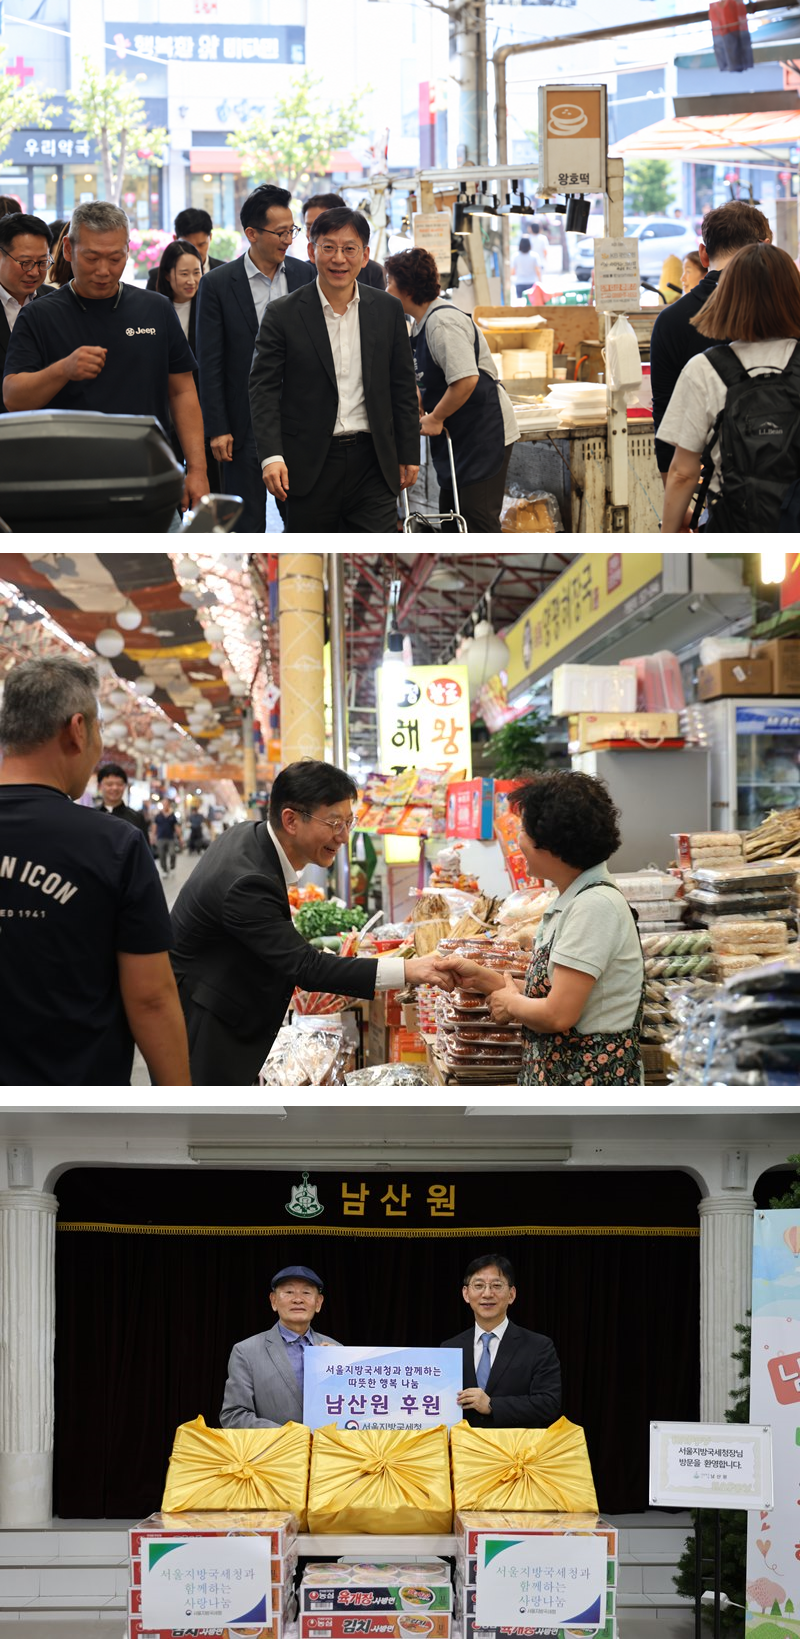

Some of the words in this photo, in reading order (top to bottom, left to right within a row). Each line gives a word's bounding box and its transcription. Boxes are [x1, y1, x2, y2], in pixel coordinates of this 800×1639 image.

[24, 138, 91, 158] 우리약국
[557, 172, 590, 186] 왕호떡
[135, 326, 156, 336] Jeep
[19, 860, 79, 905] ICON
[19, 910, 46, 918] 1941
[325, 1364, 402, 1376] 서울지방국세청과
[404, 1365, 442, 1377] 함께하는
[348, 1378, 376, 1389] 따뜻한
[379, 1378, 398, 1389] 행복
[401, 1379, 419, 1389] 나눔
[325, 1394, 389, 1415] 남산원
[400, 1394, 441, 1416] 후원
[678, 1447, 744, 1458] 서울지방국세청장님
[678, 1458, 701, 1468] 방문을
[704, 1459, 743, 1470] 환영합니다.
[160, 1567, 256, 1581] 서울지방국세청과
[496, 1565, 591, 1580] 서울지방국세청과
[184, 1582, 232, 1595] 함께하는
[519, 1581, 567, 1594] 함께하는
[319, 1591, 335, 1599] 농심
[337, 1589, 374, 1606] 육개장
[519, 1594, 567, 1608] 사랑나눔
[184, 1596, 232, 1610] 사랑나눔
[317, 1619, 333, 1627] 농심
[342, 1617, 372, 1634] 김치
